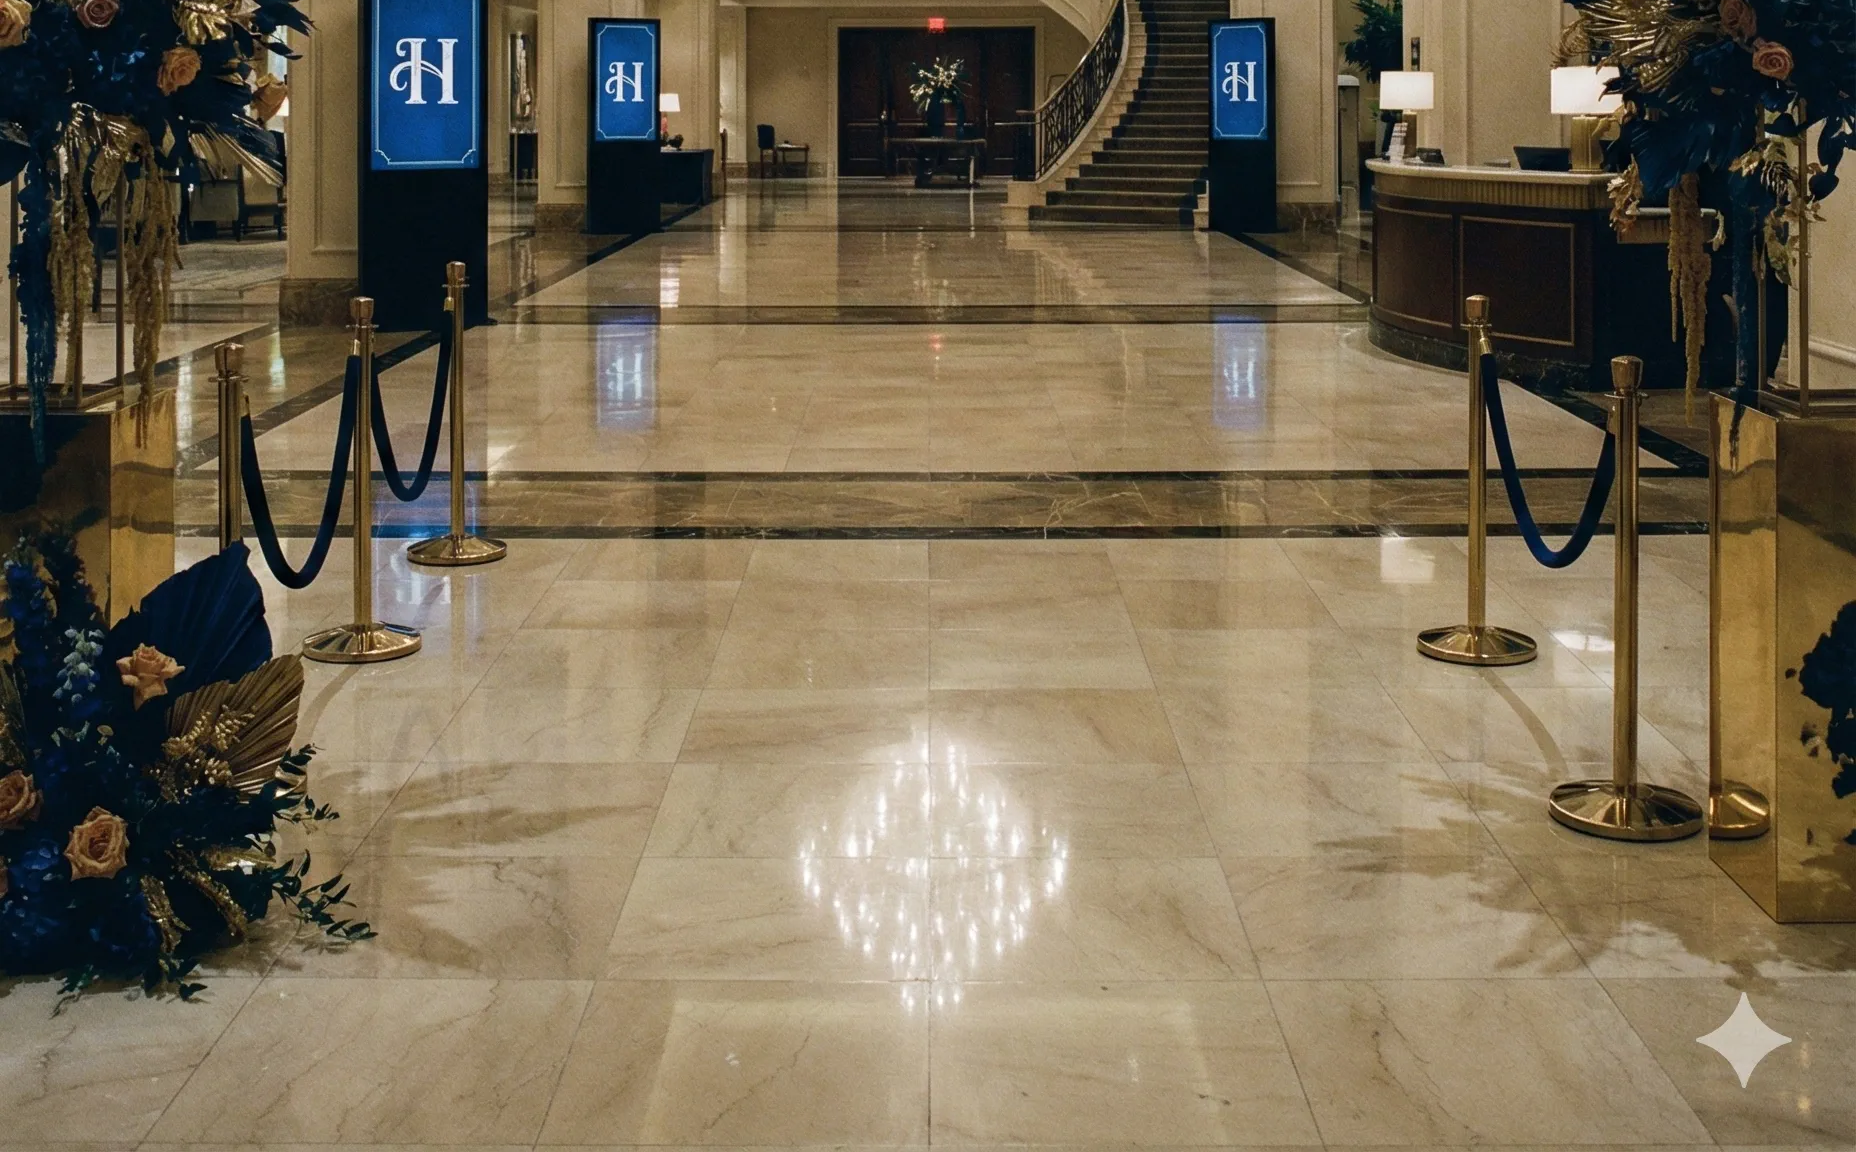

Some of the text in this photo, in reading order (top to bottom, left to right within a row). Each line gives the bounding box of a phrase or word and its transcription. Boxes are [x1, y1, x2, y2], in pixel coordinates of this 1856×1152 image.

[389, 37, 459, 105] H
[605, 61, 644, 102] H
[1222, 61, 1257, 102] H
